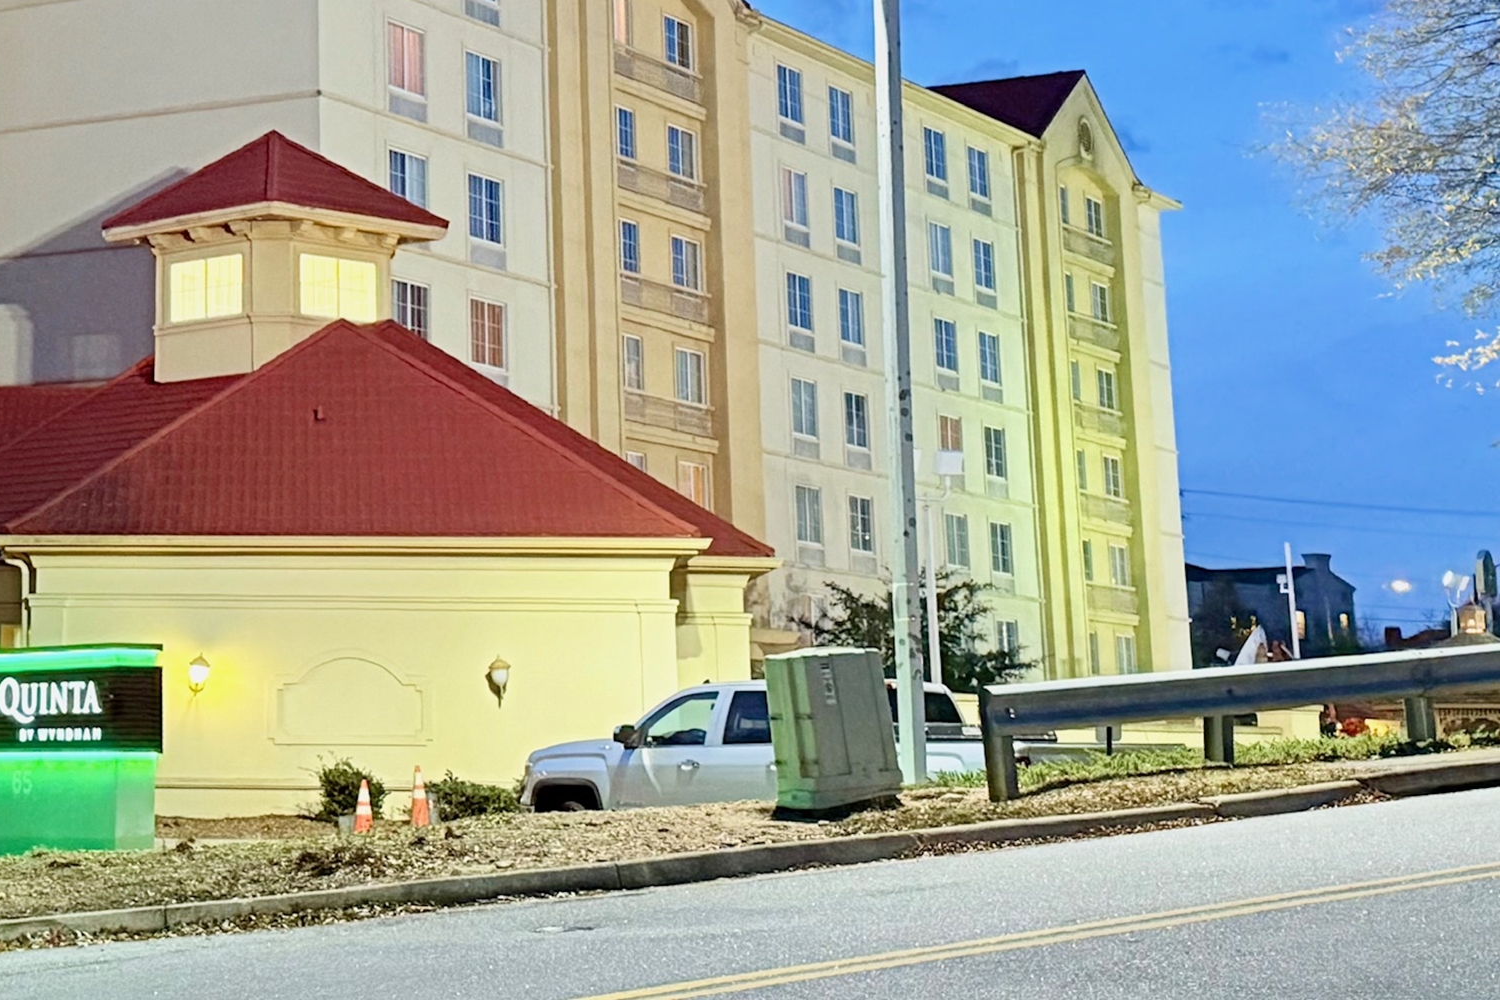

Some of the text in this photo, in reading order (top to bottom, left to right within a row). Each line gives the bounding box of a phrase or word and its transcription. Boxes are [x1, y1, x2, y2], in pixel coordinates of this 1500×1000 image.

[18, 727, 102, 742] BY WYNDHAM
[12, 770, 33, 795] 65
